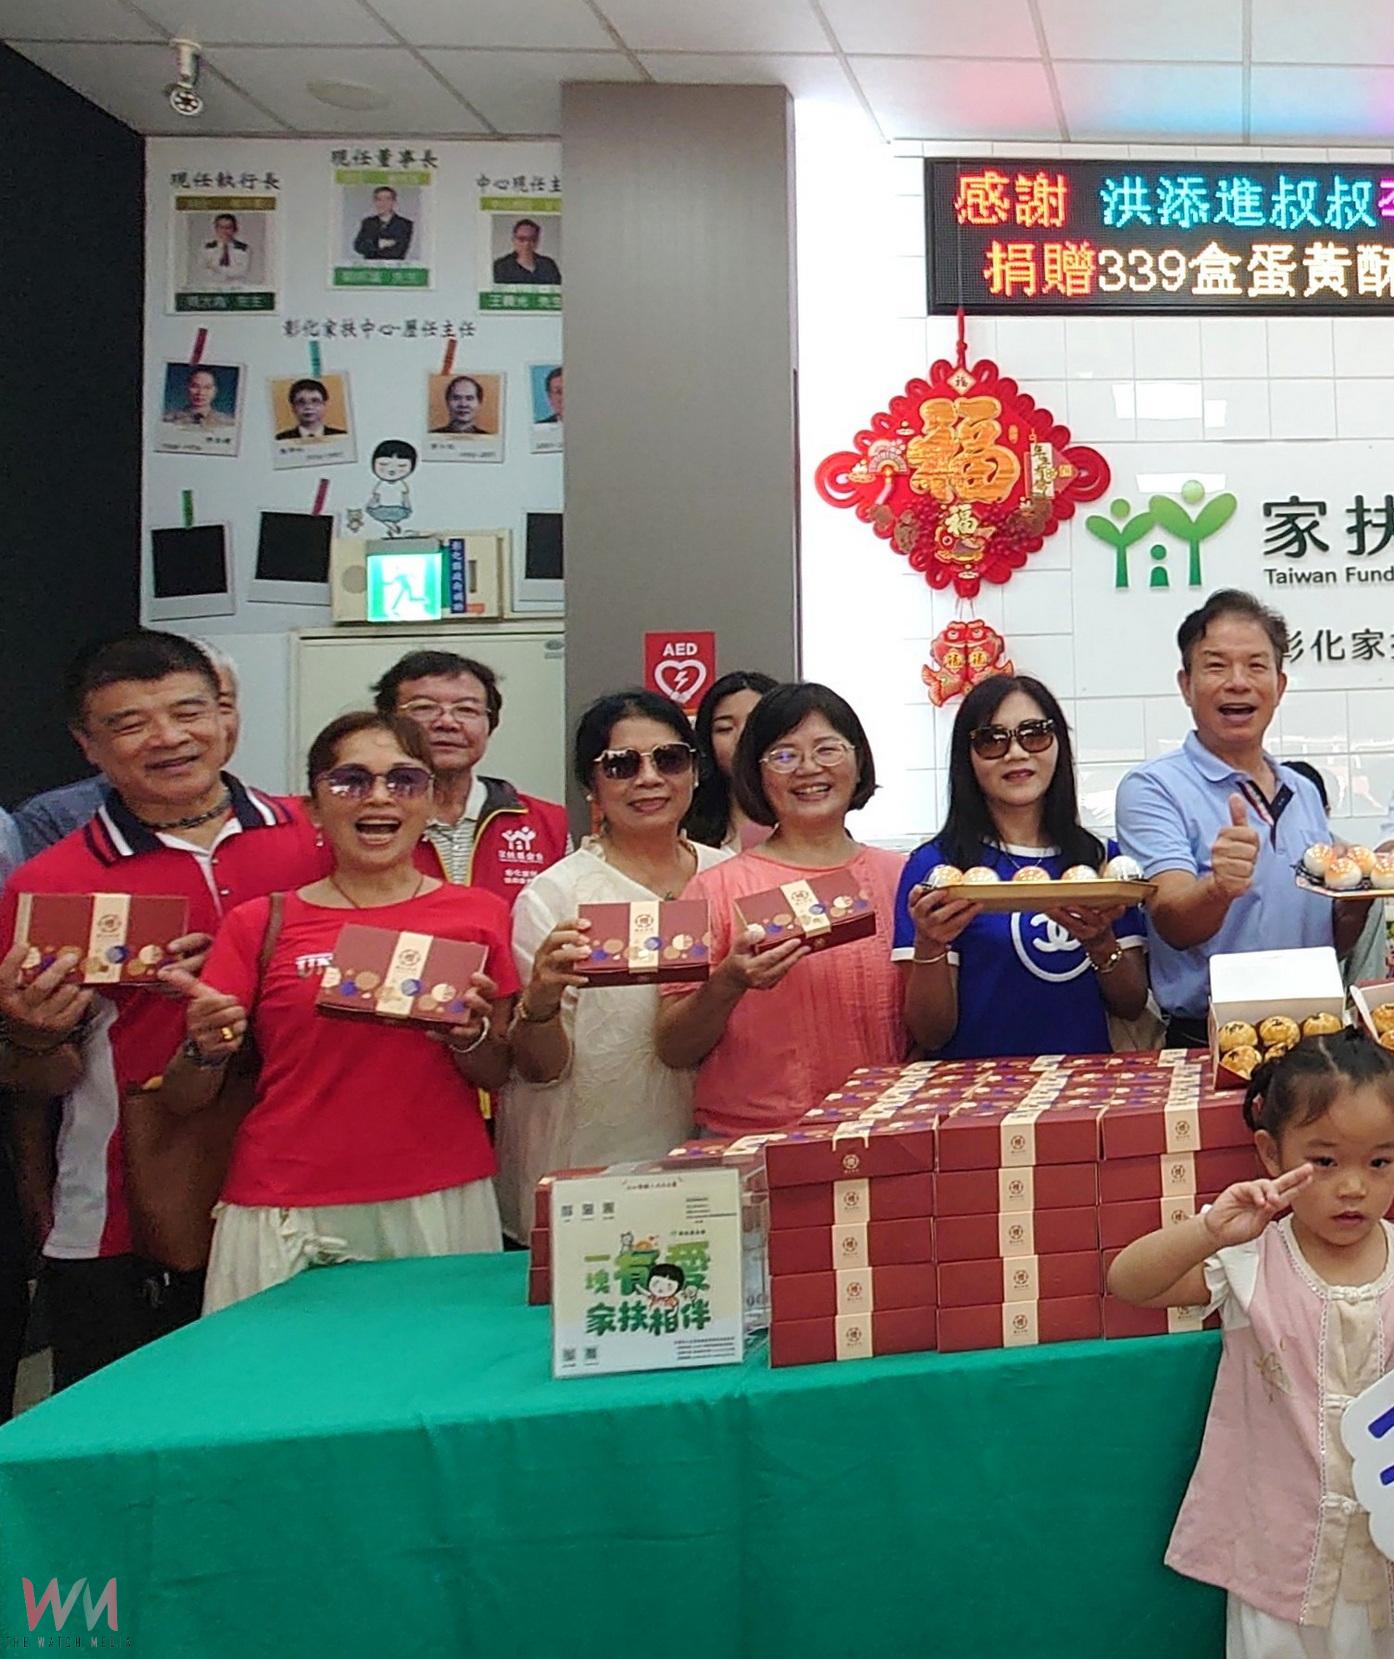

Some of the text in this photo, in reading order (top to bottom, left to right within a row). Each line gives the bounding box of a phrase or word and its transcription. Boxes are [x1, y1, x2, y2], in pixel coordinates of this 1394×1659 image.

[331, 147, 438, 169] 現任董事長
[170, 171, 281, 190] 現任執行長
[954, 171, 1068, 227] 感謝
[906, 396, 1020, 504] 福
[1264, 567, 1337, 585] Taiwan
[1346, 566, 1394, 583] Fund
[662, 642, 699, 657] AED
[586, 1299, 711, 1336] 家扶相伴
